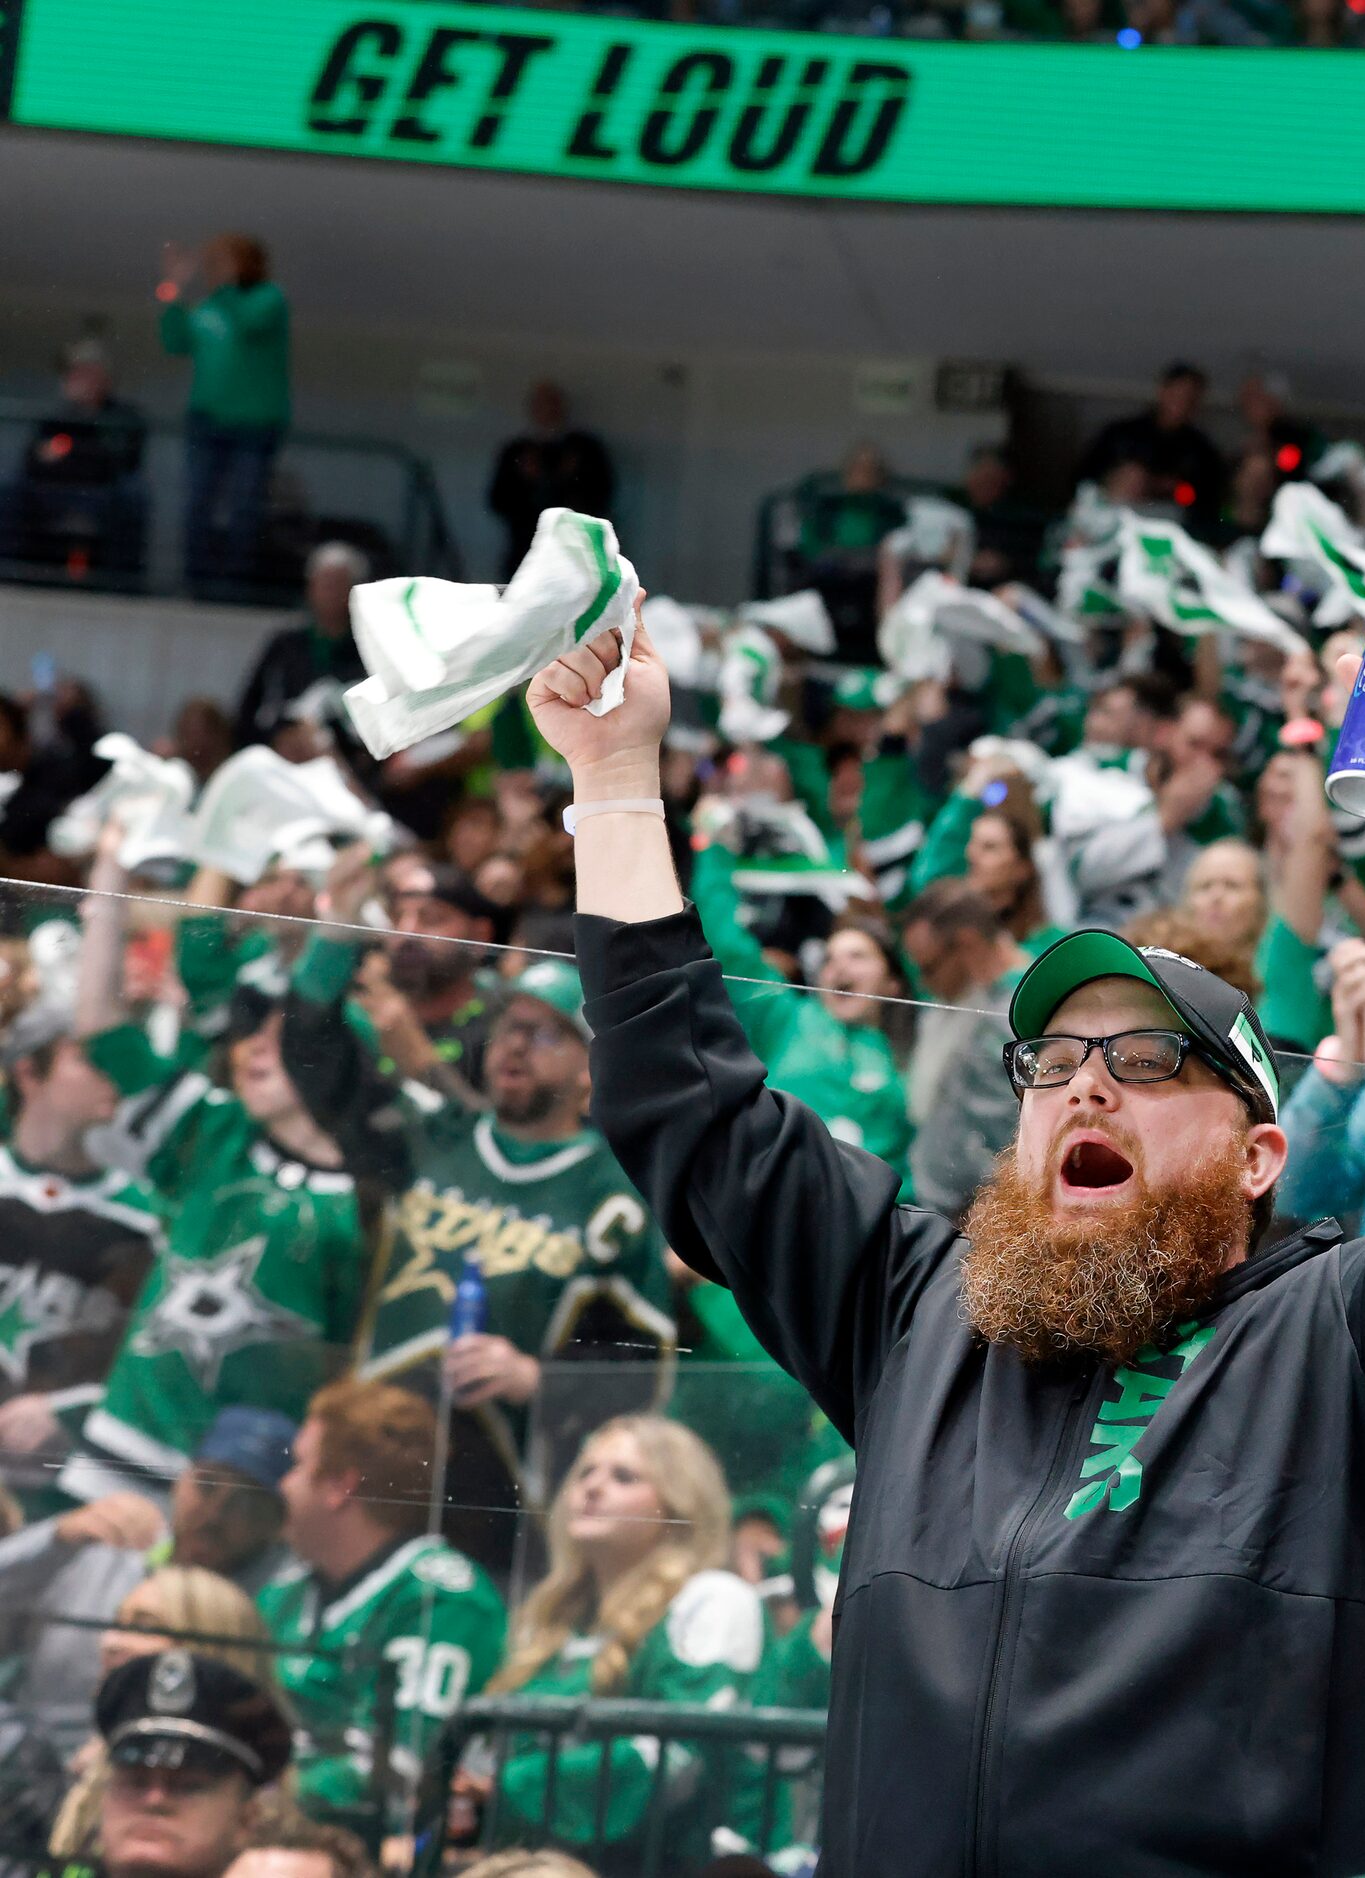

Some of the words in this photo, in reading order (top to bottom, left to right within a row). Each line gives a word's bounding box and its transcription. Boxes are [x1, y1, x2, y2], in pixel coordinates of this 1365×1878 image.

[308, 19, 554, 148] GET
[566, 43, 912, 178] LOUD
[586, 1194, 645, 1263] C
[1063, 1322, 1217, 1521] TARS
